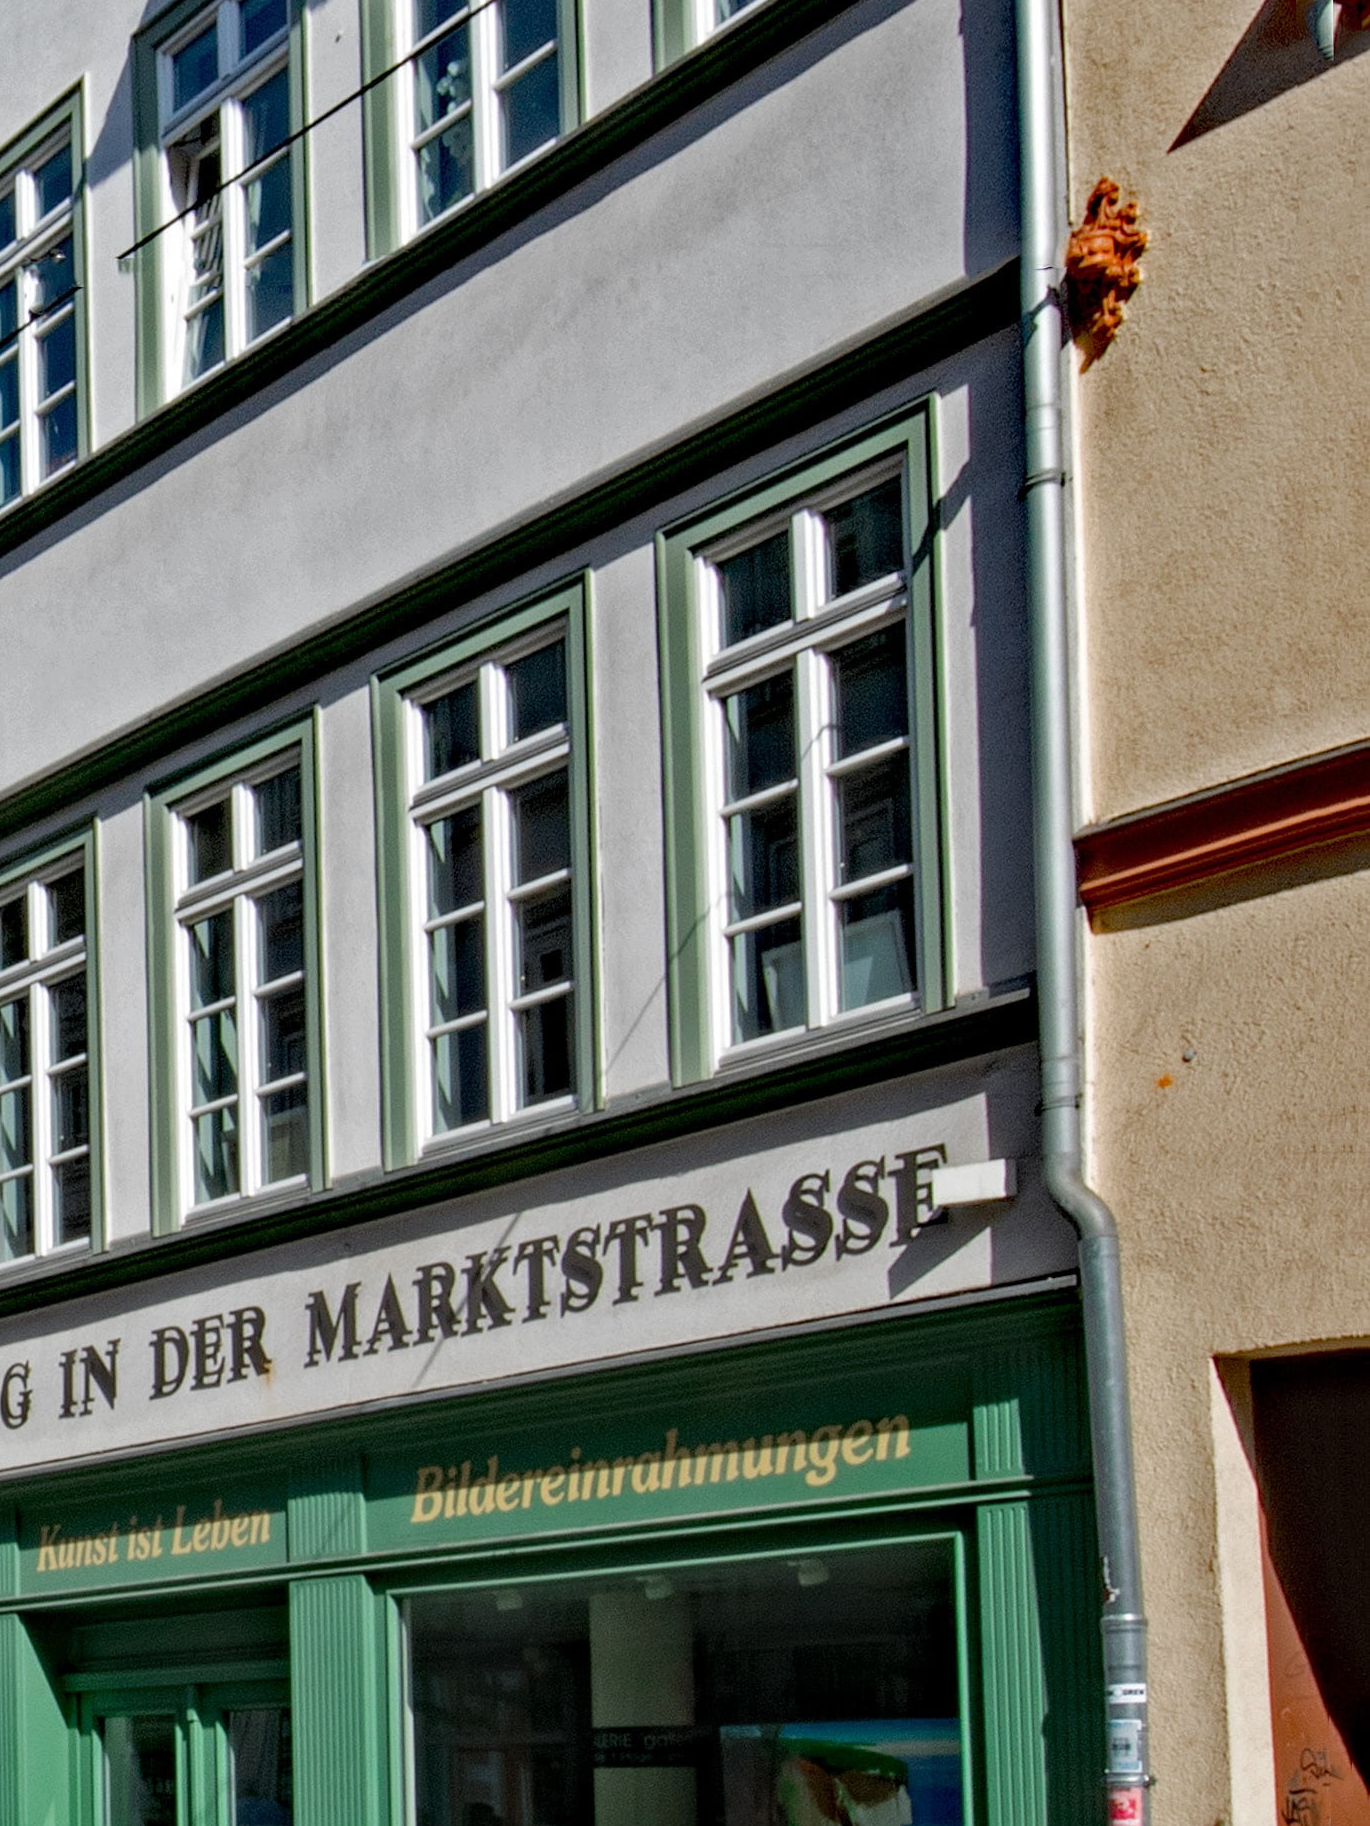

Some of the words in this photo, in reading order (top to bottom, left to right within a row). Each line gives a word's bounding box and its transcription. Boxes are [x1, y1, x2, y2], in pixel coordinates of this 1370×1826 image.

[58, 1337, 121, 1419] IN
[149, 1305, 272, 1401] DER
[304, 1143, 949, 1369] MARKTSTRASSE
[410, 1413, 910, 1524] Bildereinrahmungen
[36, 1523, 119, 1572] Kunst
[126, 1514, 163, 1561] ist
[171, 1498, 271, 1557] Leben
